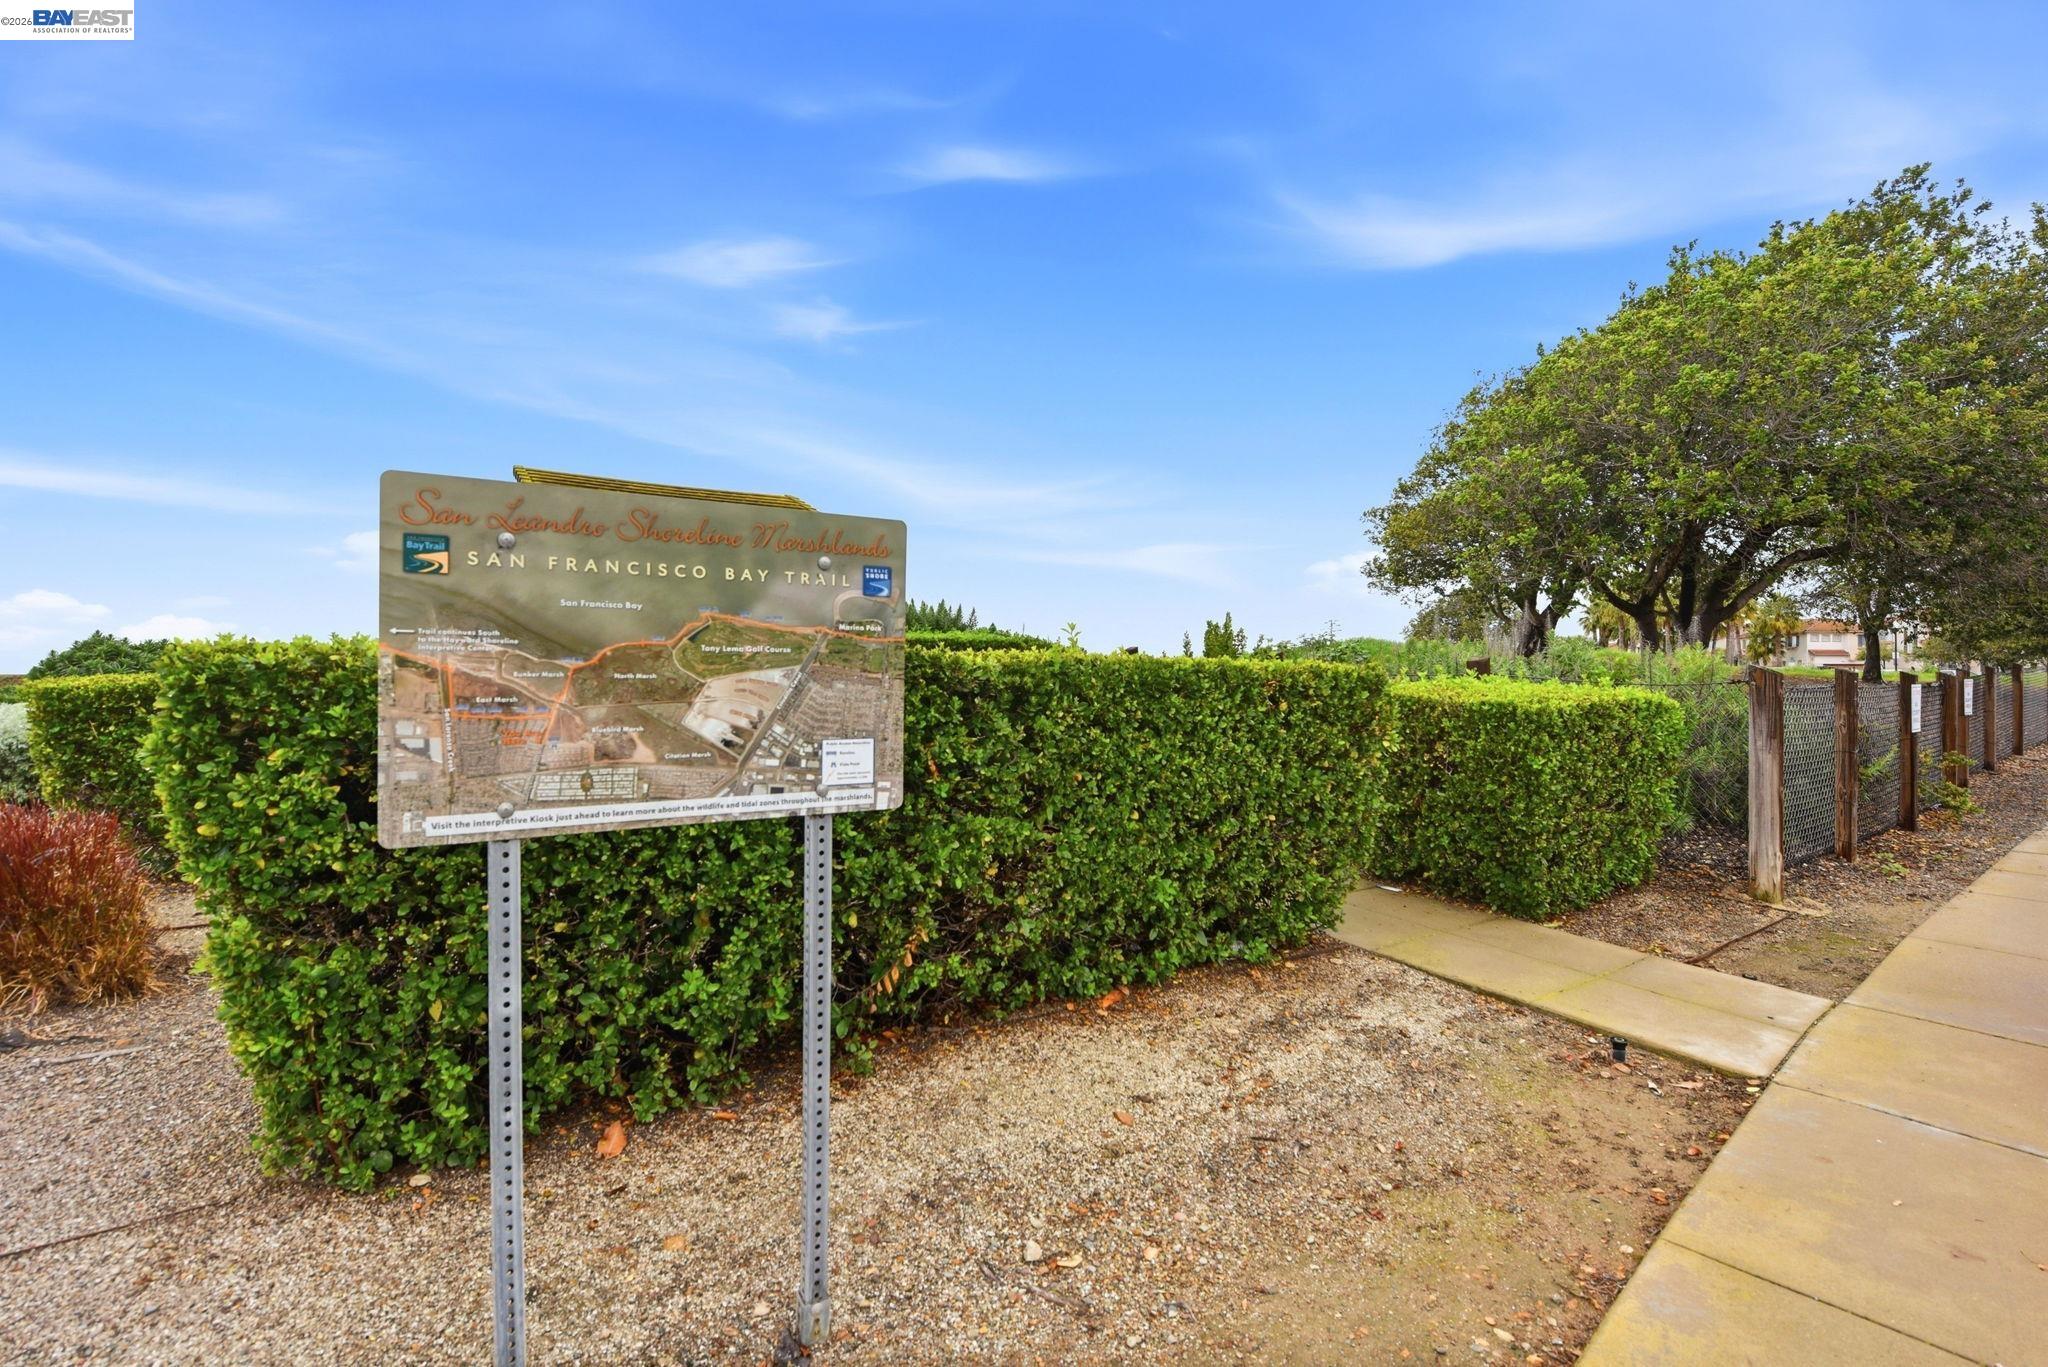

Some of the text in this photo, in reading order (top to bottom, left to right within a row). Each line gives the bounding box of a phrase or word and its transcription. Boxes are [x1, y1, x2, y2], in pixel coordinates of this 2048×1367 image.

[400, 486, 893, 559] San Leandro Shoreline Marshlands
[467, 551, 850, 587] SAN FRANCISCO BAY TRAIL
[560, 599, 643, 611] San Francisco Bay
[839, 623, 865, 631] Marina
[701, 645, 720, 653] Tony
[447, 752, 455, 773] Creek
[431, 821, 452, 829] Visit
[455, 820, 470, 828] the
[473, 817, 527, 827] interpretive
[530, 814, 553, 823] Kiosk
[556, 813, 572, 822] just
[575, 811, 600, 820] ahead
[683, 804, 695, 812] the
[781, 796, 820, 804] throughout
